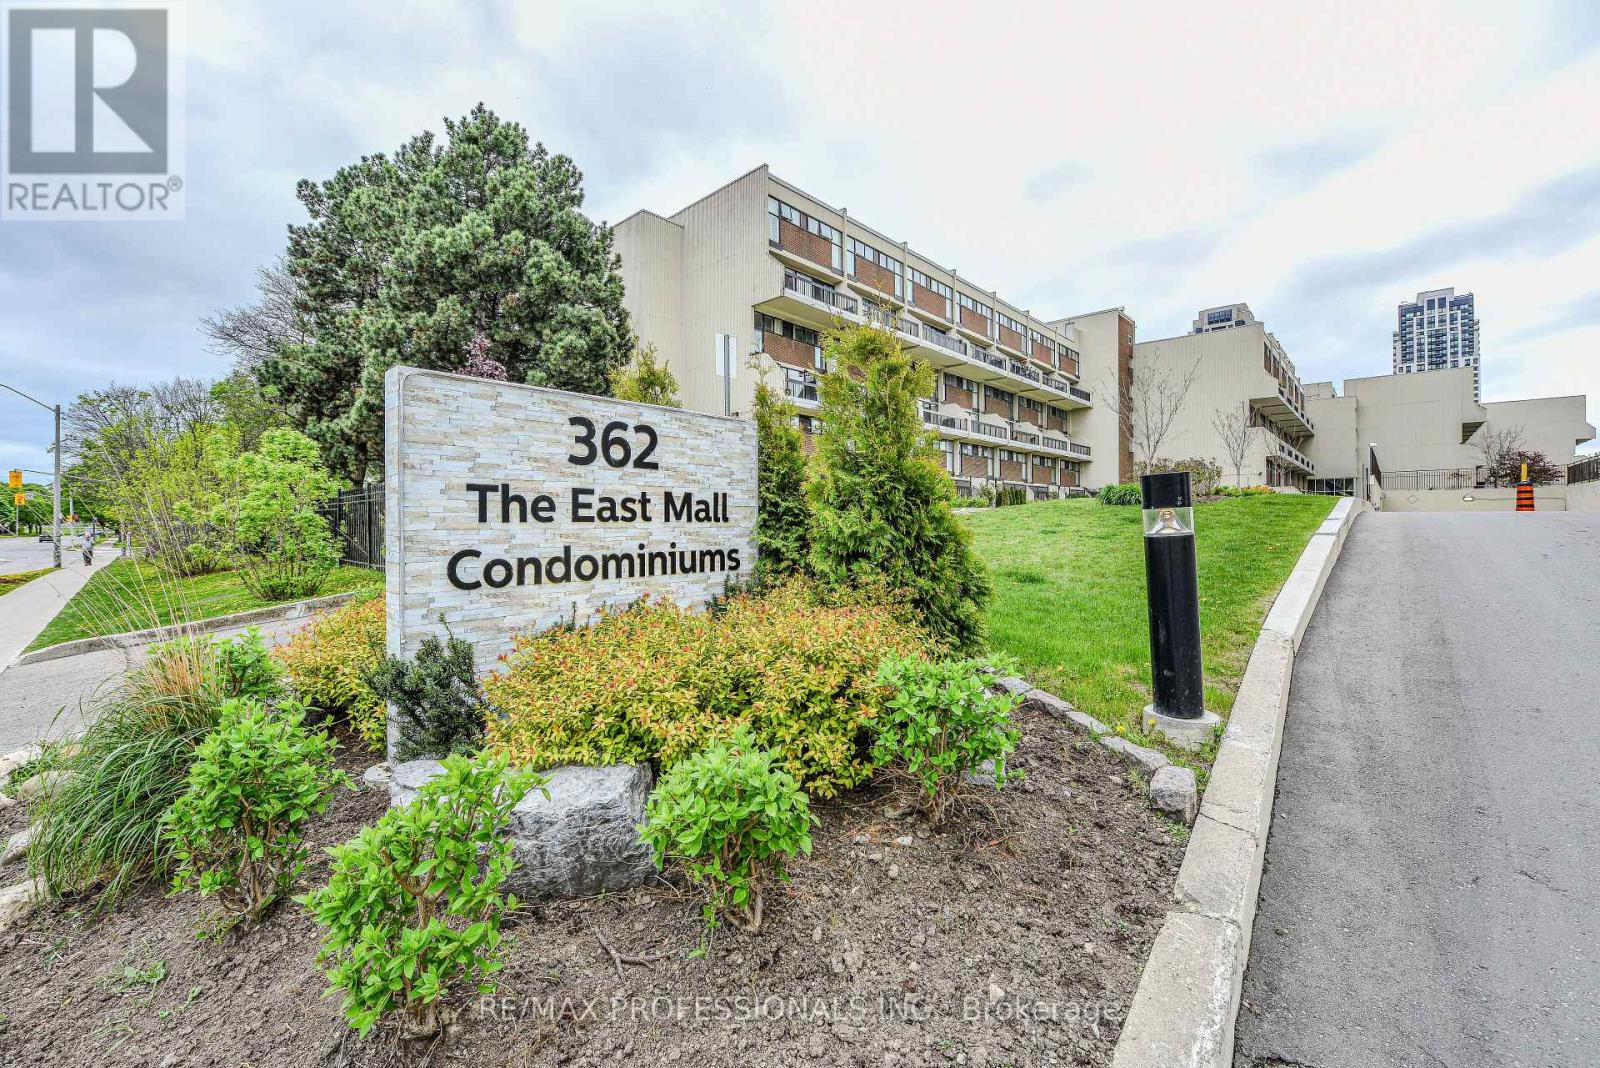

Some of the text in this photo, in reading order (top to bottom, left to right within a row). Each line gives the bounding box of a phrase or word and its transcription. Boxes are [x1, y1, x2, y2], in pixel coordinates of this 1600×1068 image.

[568, 416, 660, 470] 362
[466, 483, 729, 524] The East Mall
[446, 542, 741, 591] Condominiums
